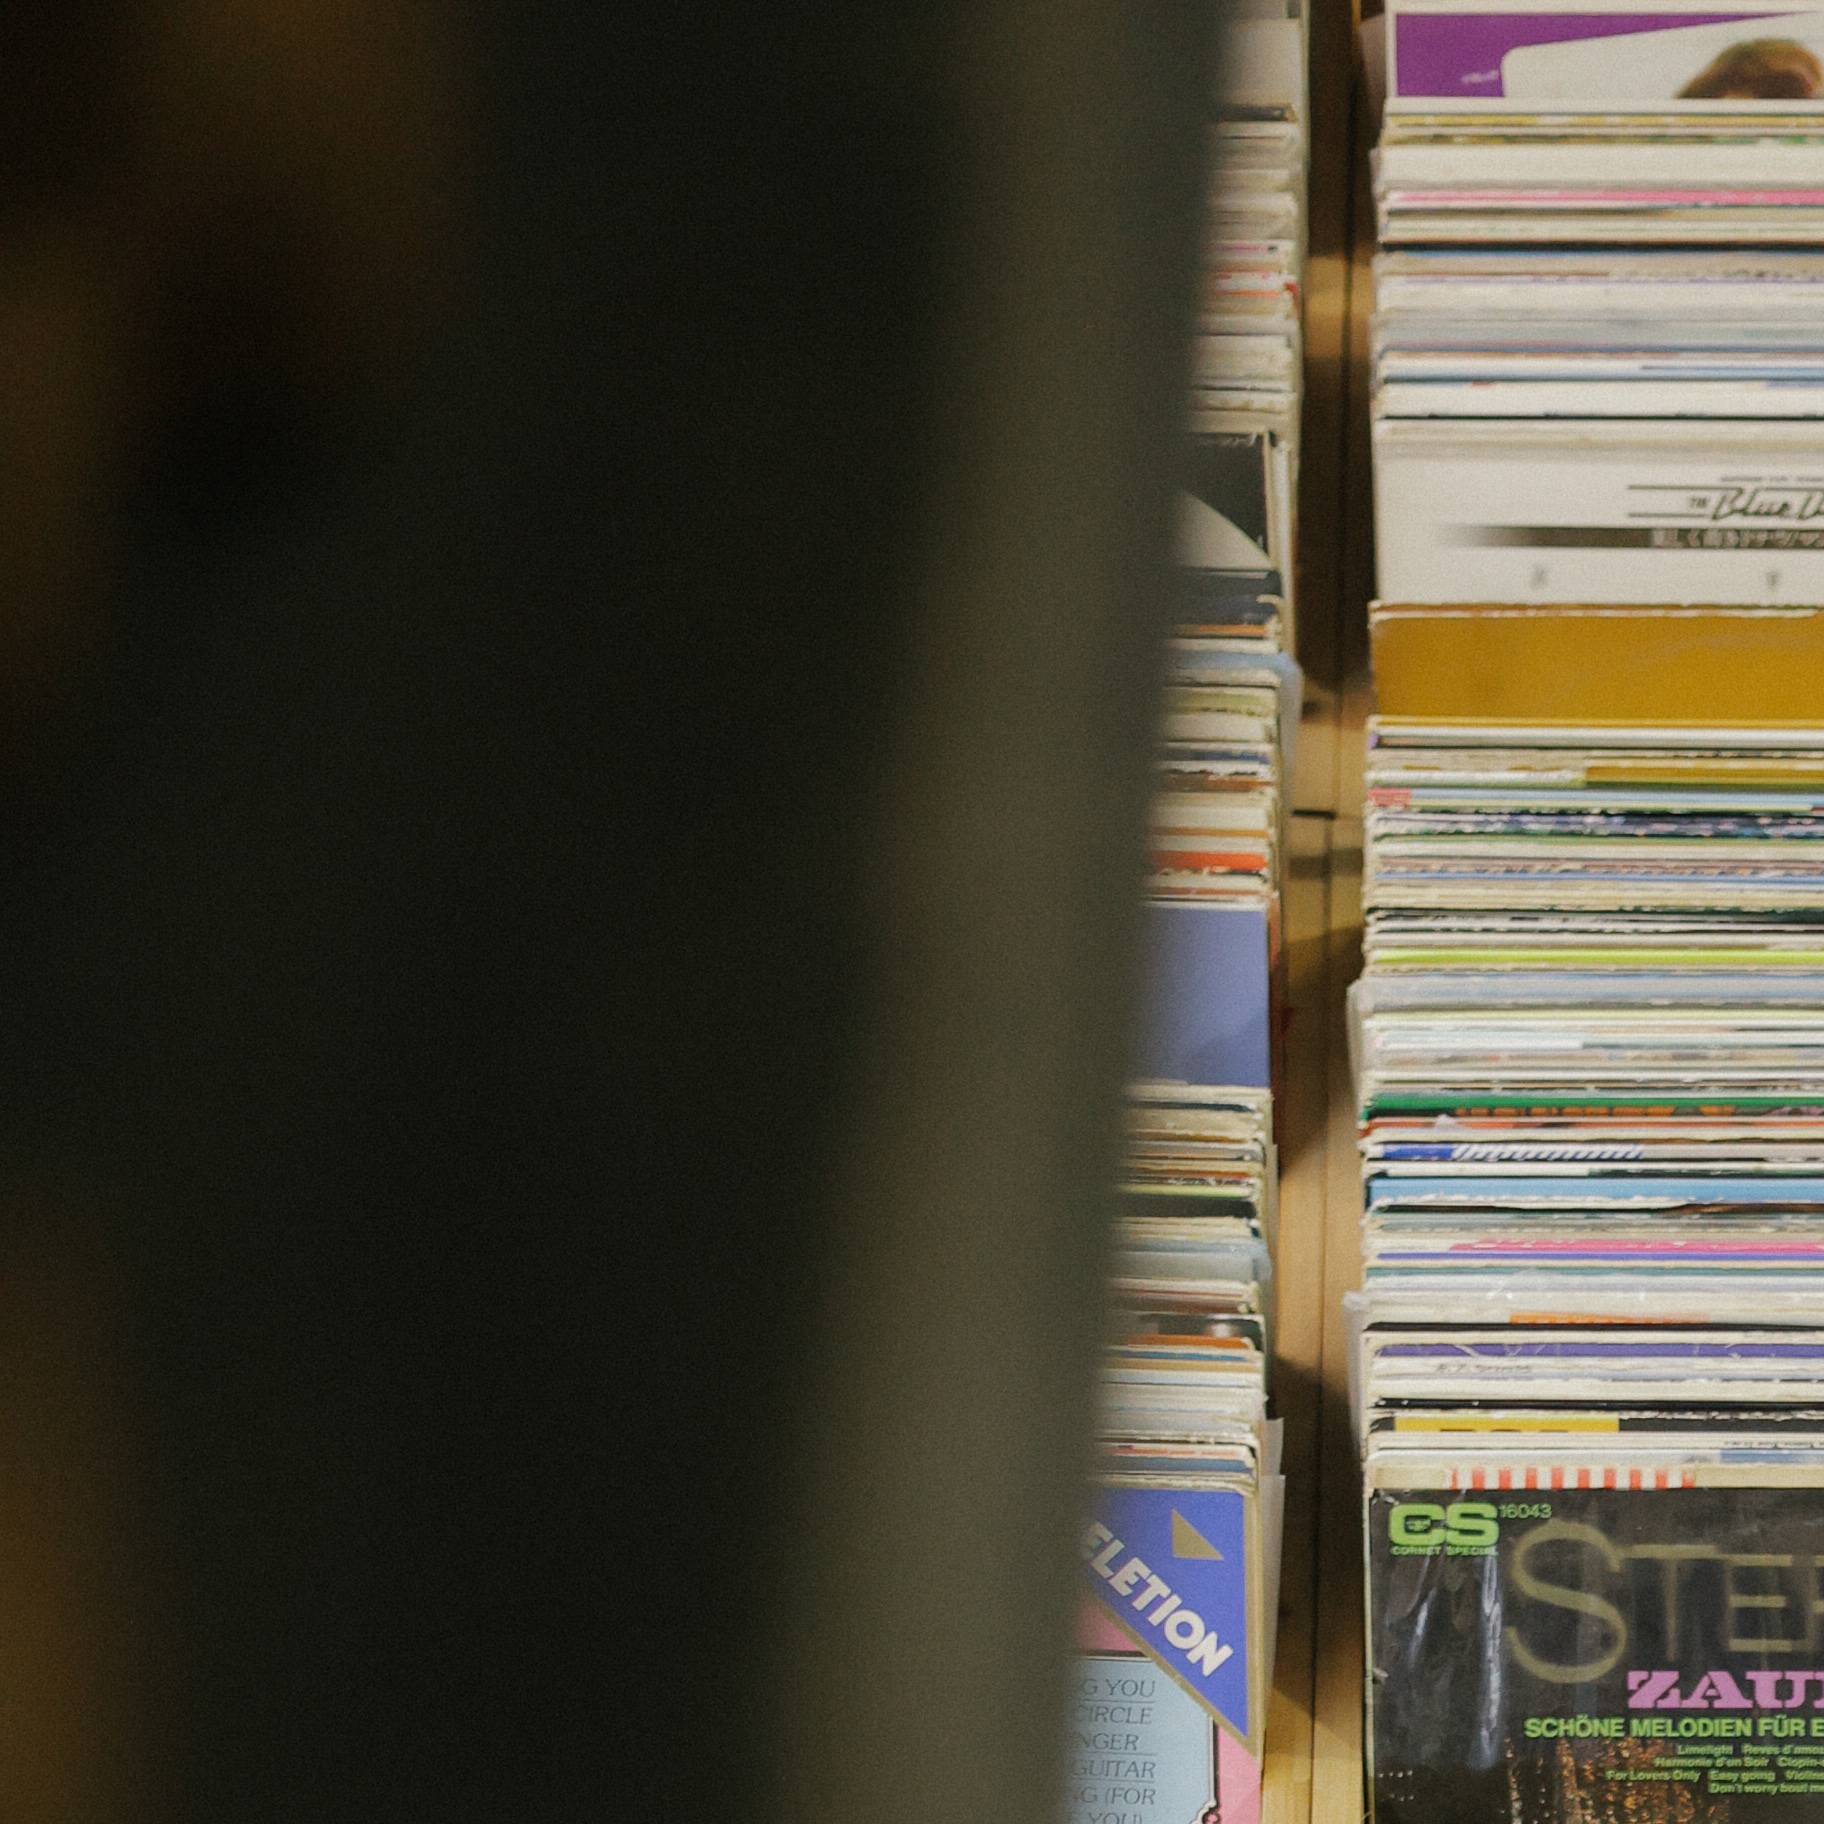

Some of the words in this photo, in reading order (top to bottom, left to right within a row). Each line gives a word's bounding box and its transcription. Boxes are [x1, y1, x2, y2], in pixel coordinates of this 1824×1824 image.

[1711, 486, 1791, 521] Blue
[1499, 1503, 1552, 1519] 16043
[1389, 1502, 1500, 1546] CS
[1105, 1678, 1156, 1698] YOU
[1524, 1714, 1625, 1738] SCHÖNE
[1631, 1717, 1752, 1738] MELODIEN
[1757, 1714, 1806, 1738] FÜR
[1605, 1770, 1627, 1781] For
[1672, 1770, 1701, 1783] Only
[1709, 1770, 1739, 1783] Easy
[1741, 1771, 1776, 1783] going
[1105, 1786, 1156, 1807] (FOR
[1743, 1784, 1778, 1796] worry
